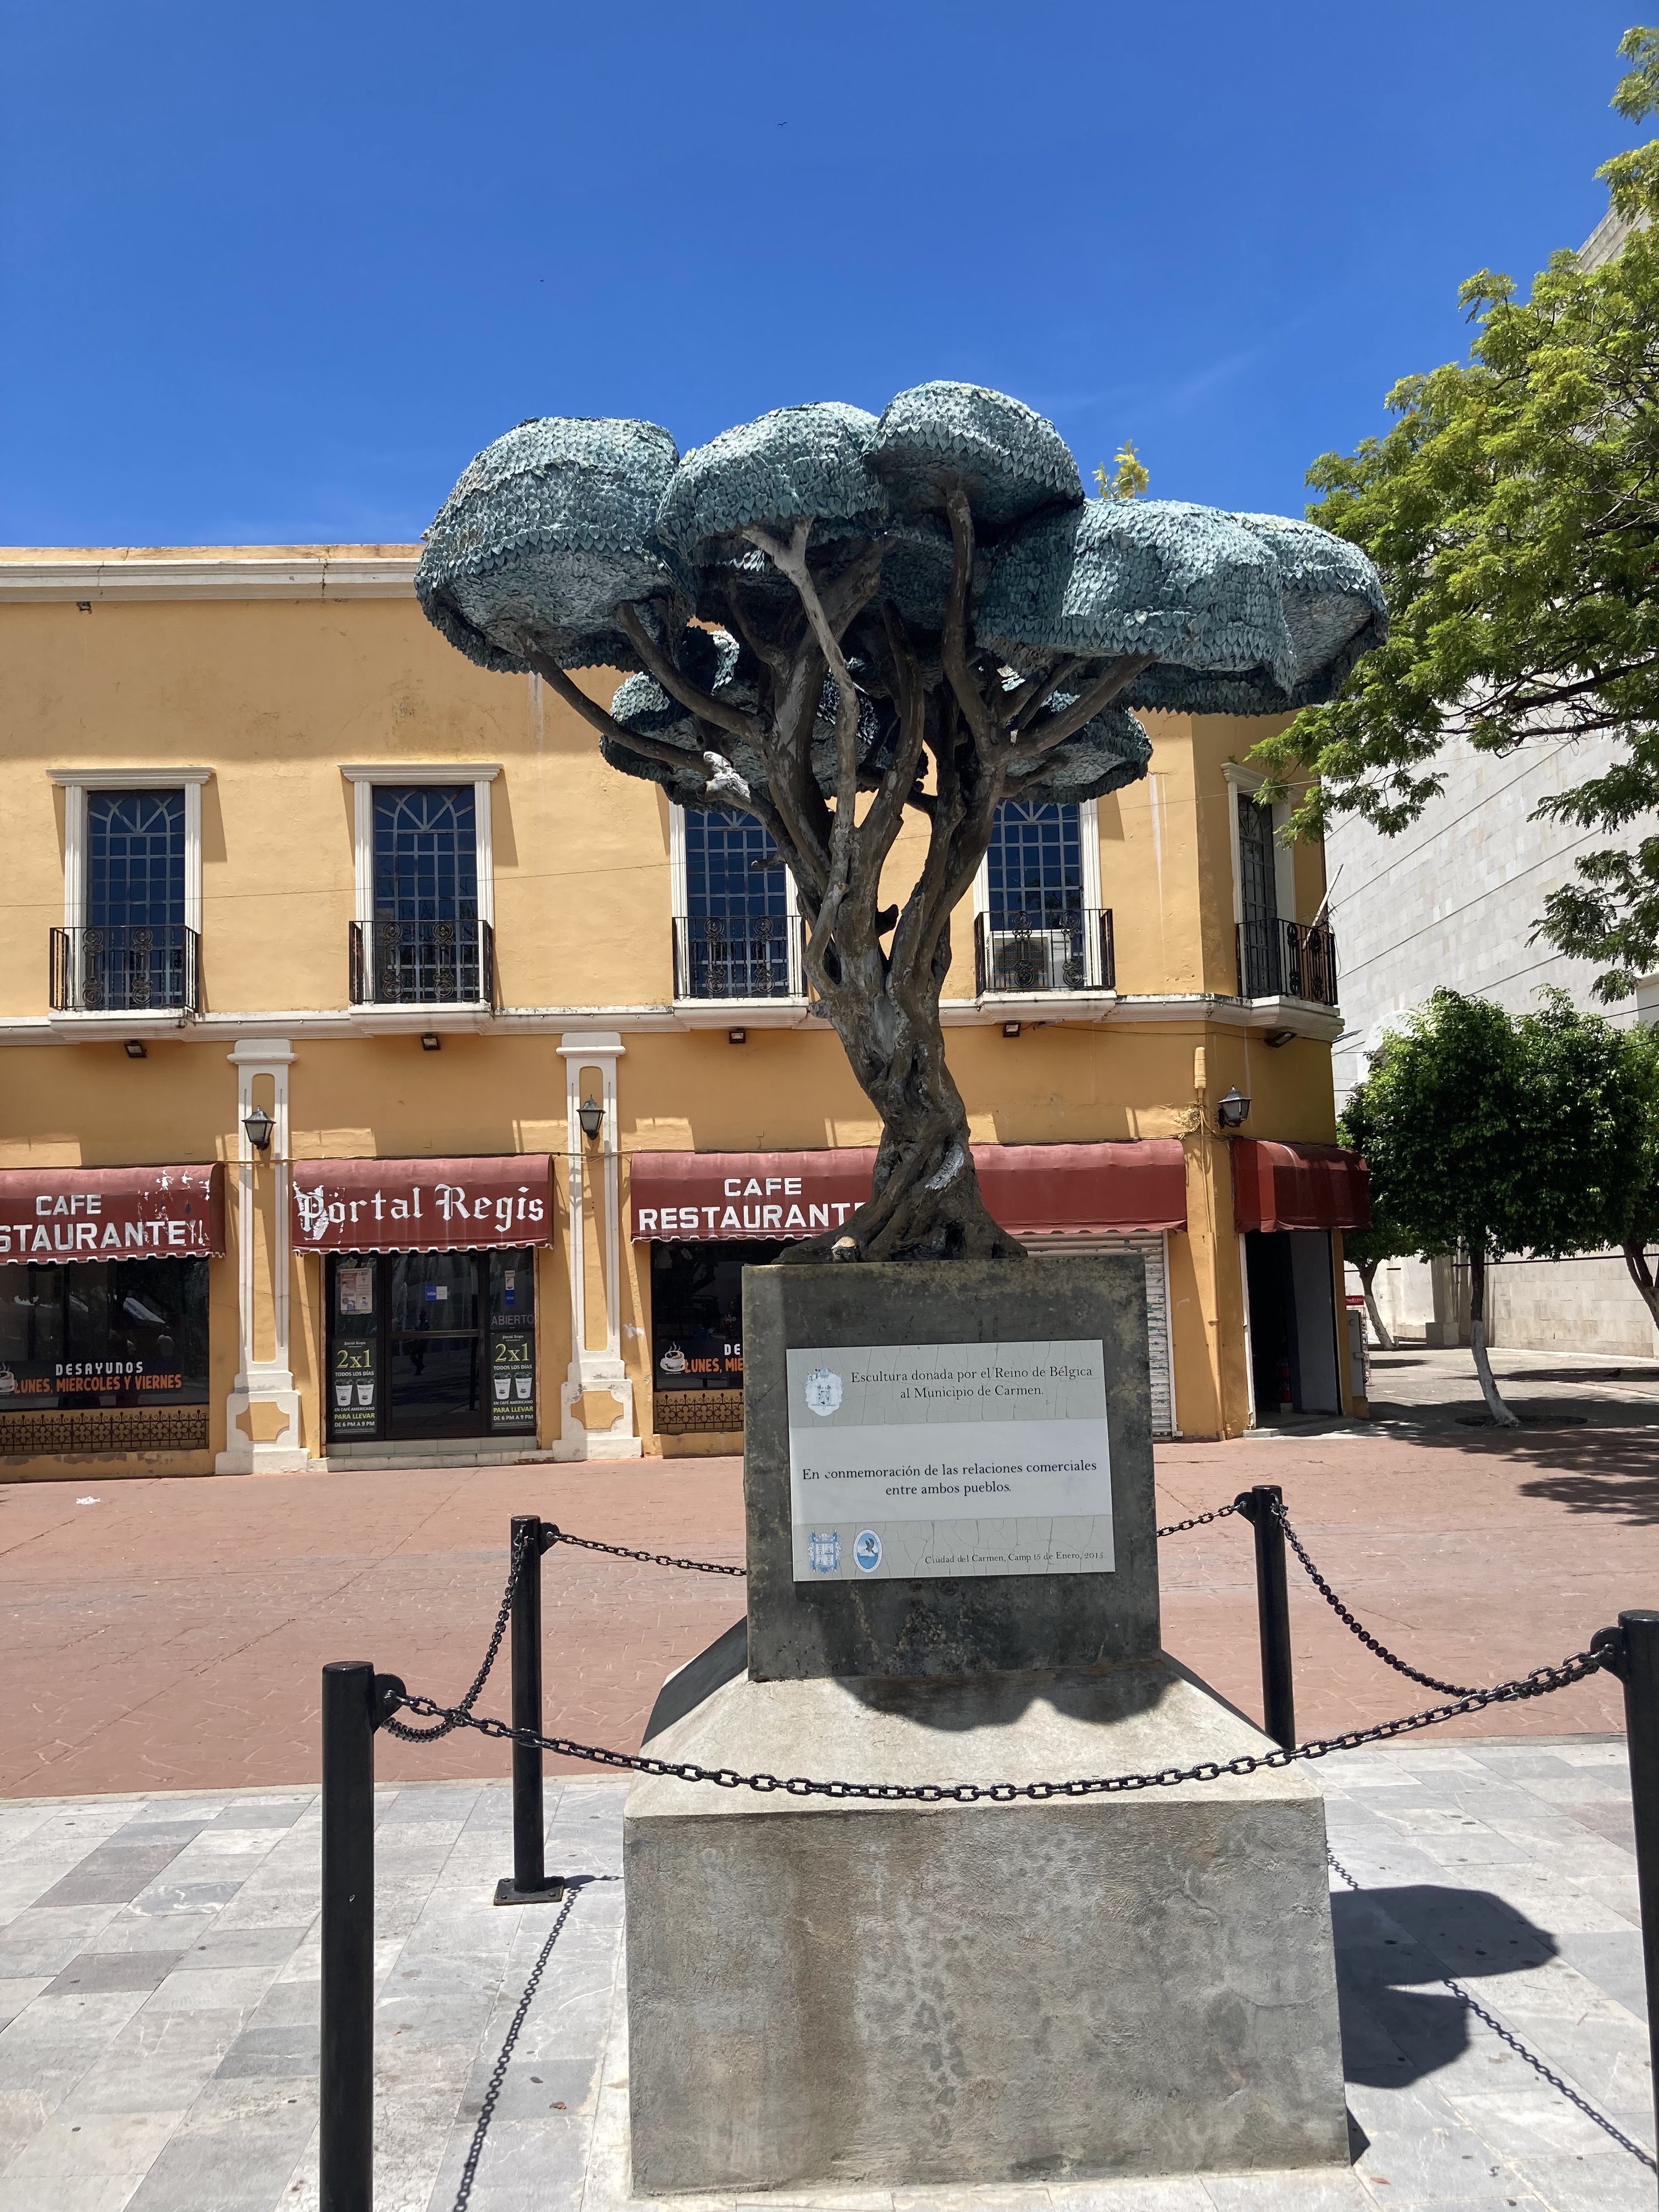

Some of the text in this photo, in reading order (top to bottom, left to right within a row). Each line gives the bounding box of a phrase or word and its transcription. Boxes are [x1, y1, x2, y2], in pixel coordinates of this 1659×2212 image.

[725, 1177, 802, 1197] CAFE
[36, 1194, 101, 1216] CAFE
[295, 1183, 544, 1232] Portal Regis
[639, 1202, 866, 1231] RESTAURANT
[492, 1314, 534, 1325] ABIERTO
[337, 1349, 371, 1368] 2x1
[495, 1342, 529, 1362] 2x1
[55, 1362, 143, 1376] DESAYUNOS
[684, 1357, 722, 1374] LUNES,
[851, 1365, 1093, 1383] Escultura donada por el Reino de Bélgica
[14, 1374, 182, 1395] LUNES, MIERCOLES Y VIERNES
[900, 1385, 1044, 1400] al Municipio de Carmen.
[803, 1460, 1097, 1480] En conmemoración de las relaciones comerciales
[885, 1481, 1012, 1497] entre ambos pueblos.
[925, 1555, 955, 1564] Ciudad
[957, 1554, 969, 1562] del
[972, 1554, 1007, 1562] Carmen,
[1043, 1552, 1053, 1560] de
[1056, 1551, 1082, 1560] Enero,
